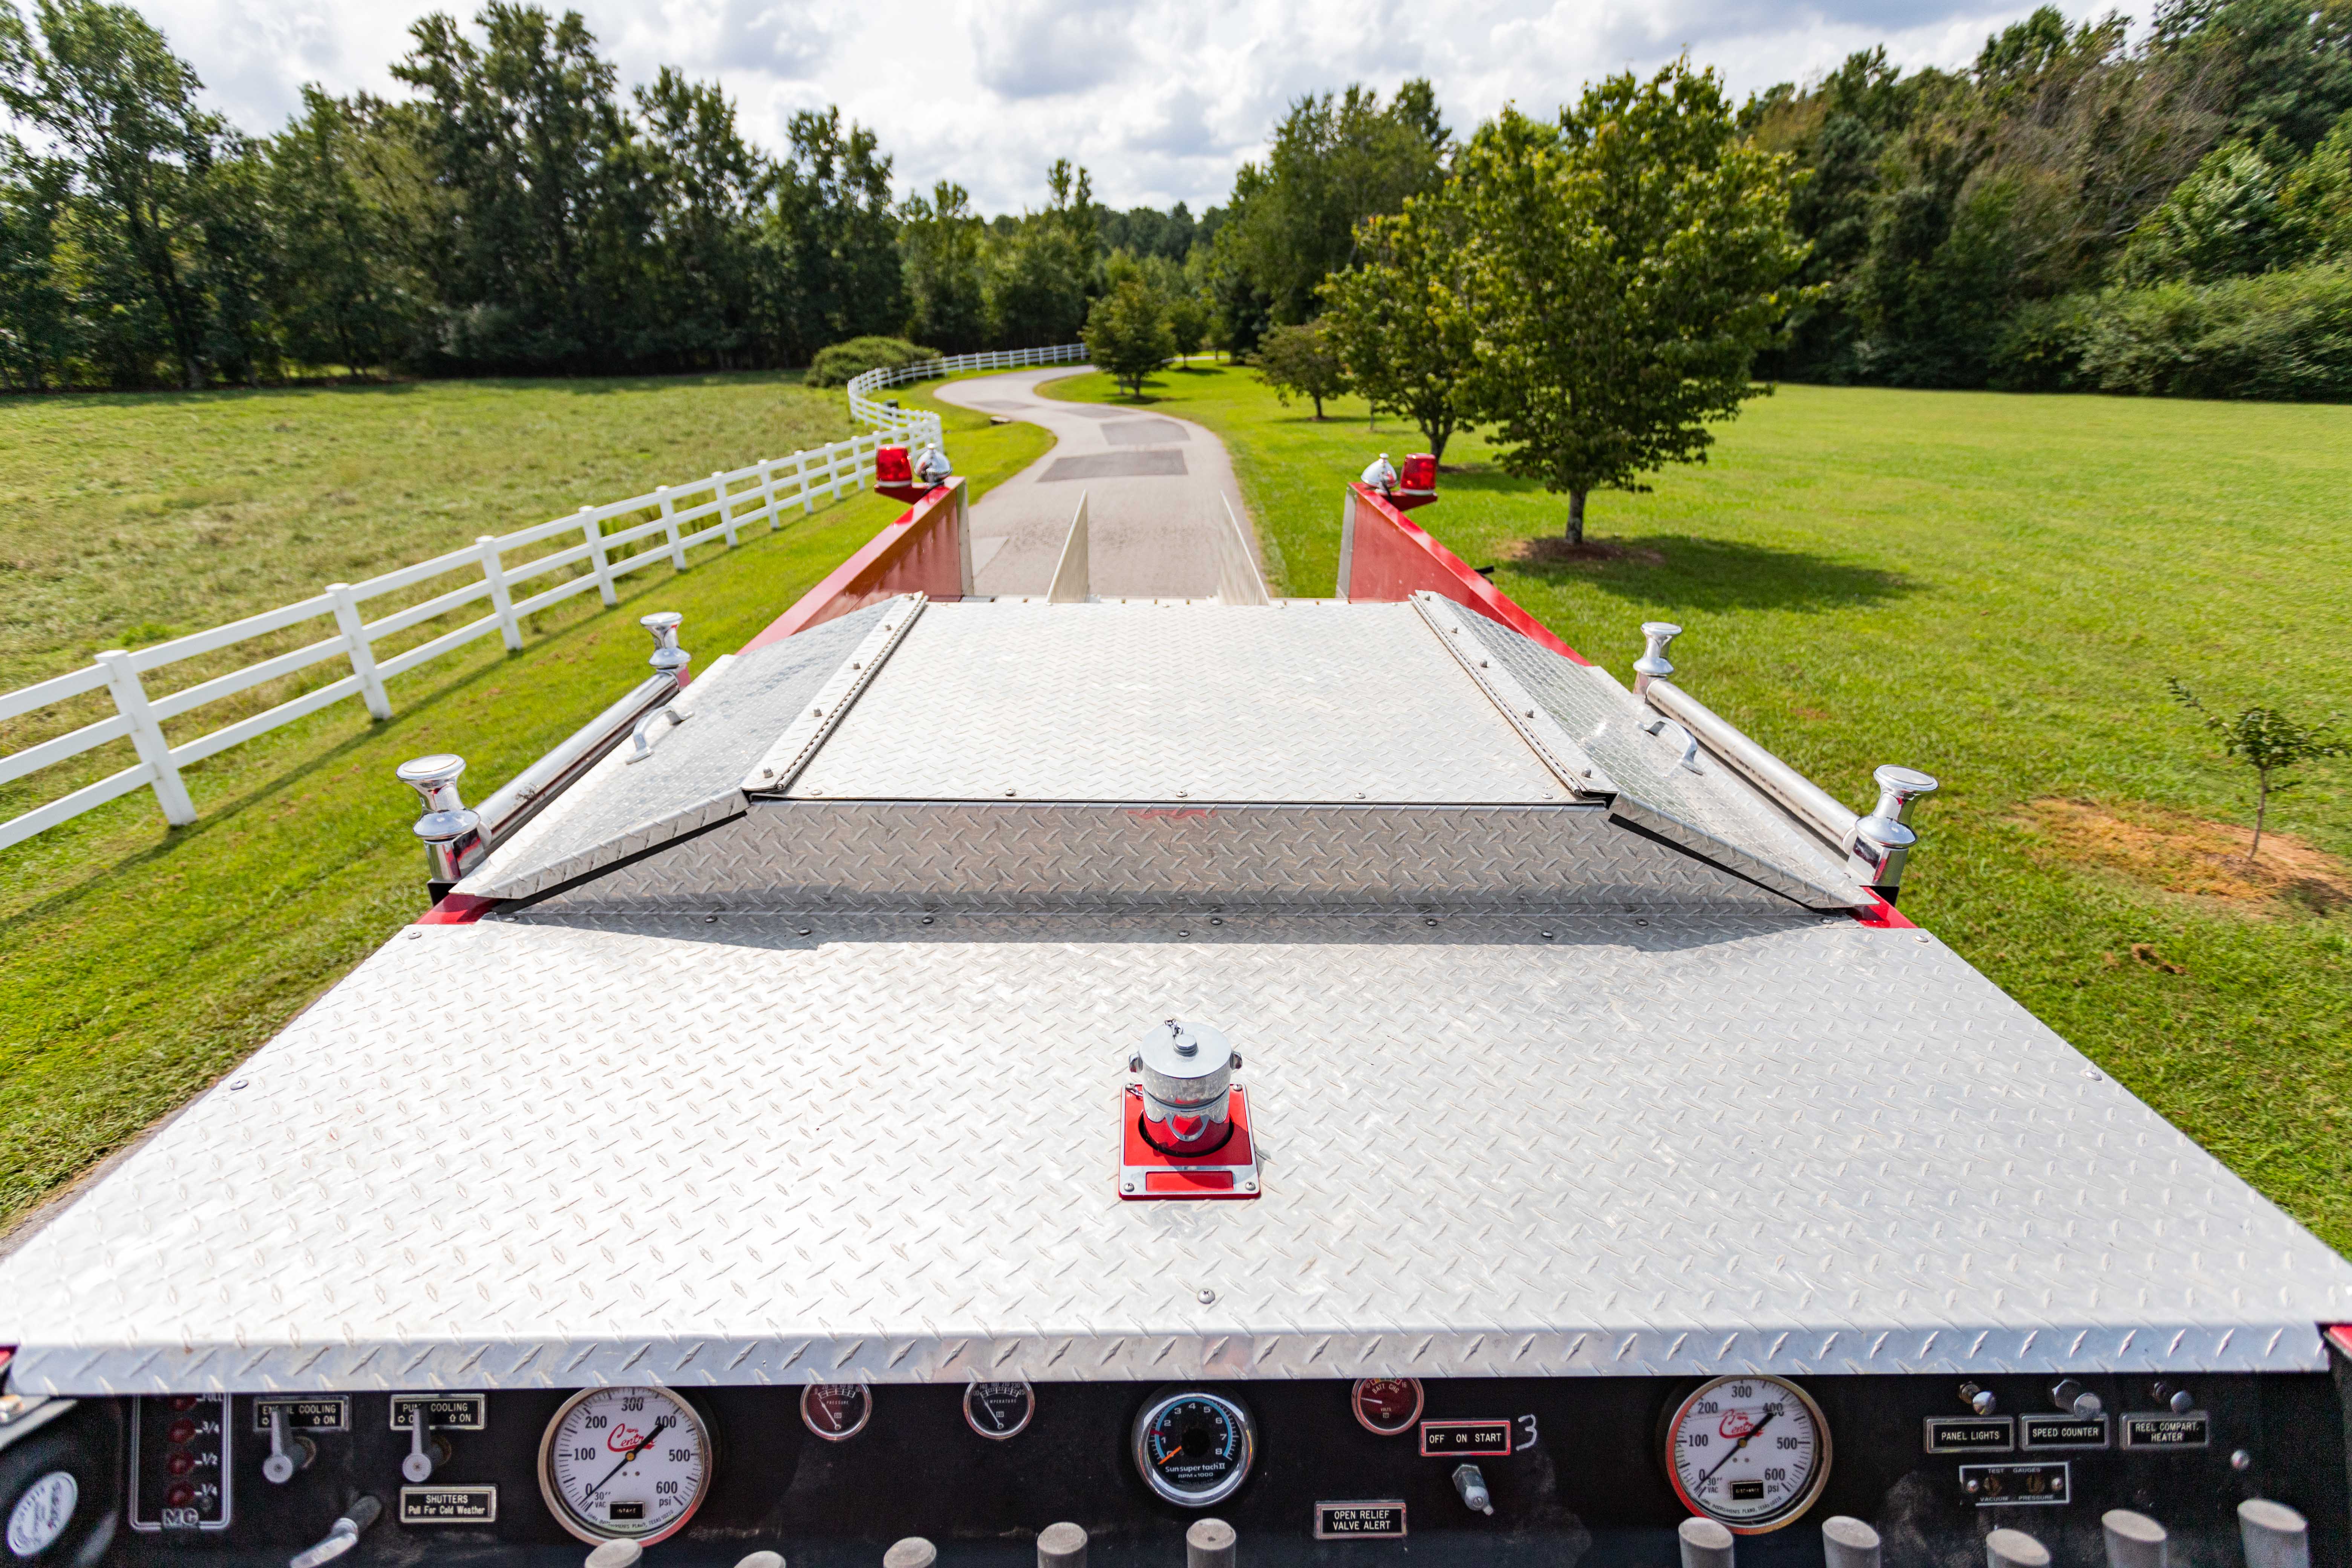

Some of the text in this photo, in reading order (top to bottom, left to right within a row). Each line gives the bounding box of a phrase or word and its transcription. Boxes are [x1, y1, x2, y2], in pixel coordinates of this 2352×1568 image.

[1372, 1383, 1399, 1394] BATT CHG
[1731, 1386, 1752, 1398] 300
[299, 1404, 336, 1414] COOLING
[430, 1403, 468, 1412] COOLING
[621, 1397, 644, 1411] 300
[1698, 1402, 1718, 1414] 200
[323, 1415, 335, 1424] ON
[459, 1413, 471, 1423] ON
[585, 1415, 607, 1429] 200
[654, 1415, 677, 1429] 400
[202, 1420, 219, 1434] 3/4
[1516, 1413, 1537, 1451] 3
[2032, 1427, 2098, 1437] SPEED COUNTER
[2135, 1422, 2199, 1432] REEL COMPART.
[1429, 1433, 1502, 1444] OFF ON START
[1689, 1434, 1709, 1447] 100
[1942, 1431, 2000, 1441] PANEL LIGHTS
[2151, 1433, 2183, 1442] HEATER
[1777, 1437, 1798, 1450] 500
[202, 1452, 218, 1466] 1/2
[574, 1448, 596, 1461] 100
[669, 1449, 691, 1462] 500
[1699, 1468, 1706, 1481] 0
[1764, 1468, 1785, 1481] 600
[202, 1484, 218, 1496] 1/4
[585, 1483, 593, 1496] 0
[656, 1481, 678, 1494] 600
[1767, 1482, 1779, 1494] psi
[426, 1494, 469, 1504] SHUTTERS
[659, 1495, 671, 1508] psi
[408, 1505, 485, 1514] Pull For Cold Weather
[1334, 1510, 1390, 1520] OPEN RELIEF
[1333, 1520, 1390, 1530] VALVE ALERT
